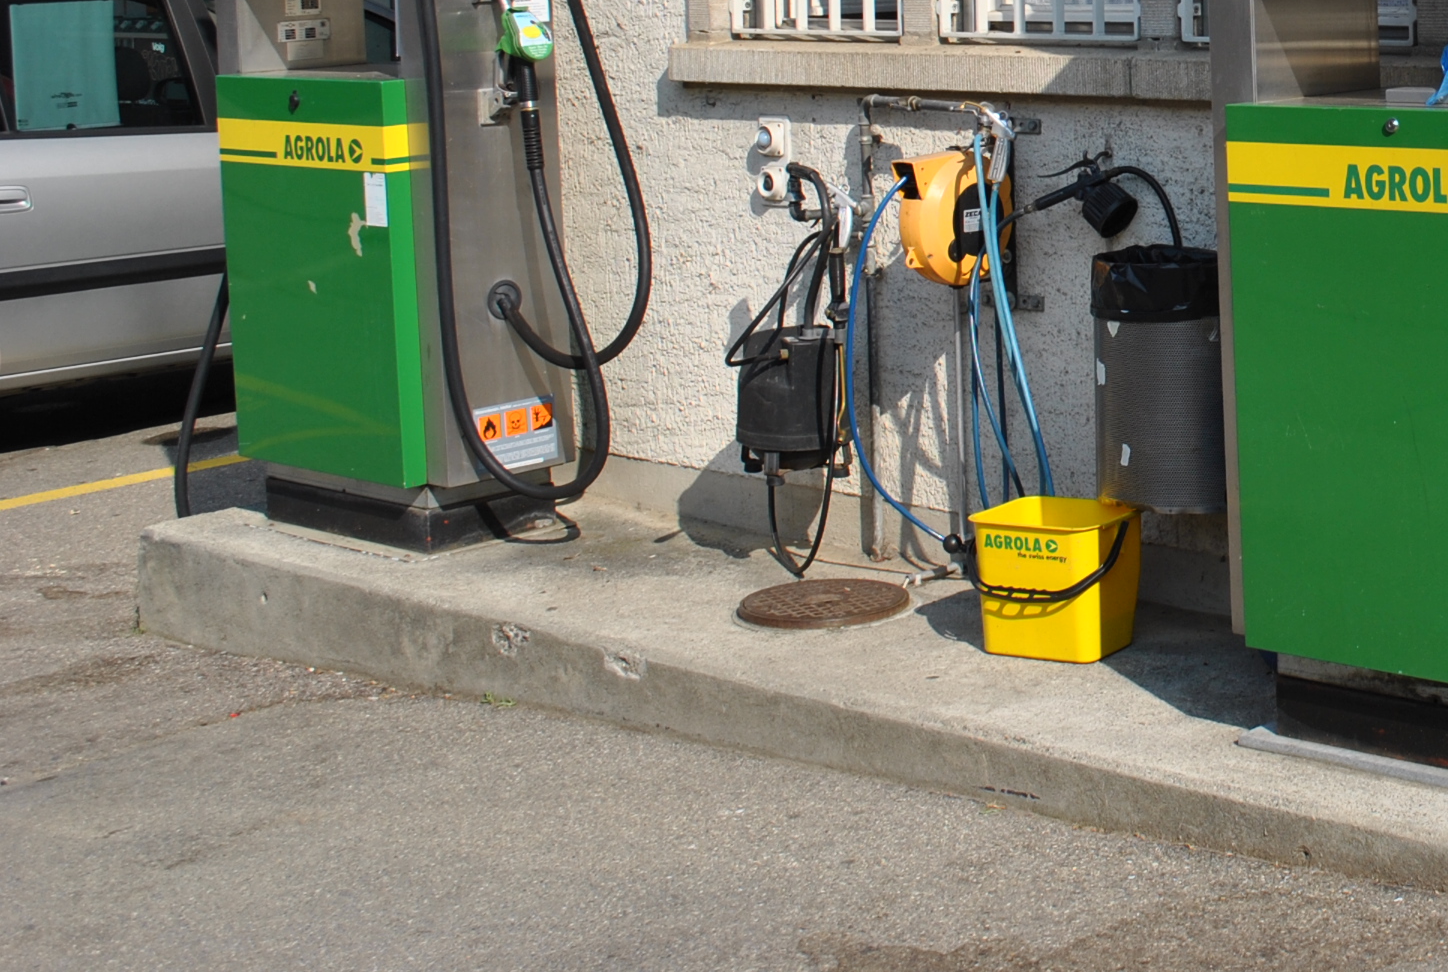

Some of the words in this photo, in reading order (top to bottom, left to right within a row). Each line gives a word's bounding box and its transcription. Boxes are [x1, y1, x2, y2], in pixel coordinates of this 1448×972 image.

[283, 134, 346, 164] AGROLA
[984, 533, 1042, 553] AGROLA
[1029, 552, 1044, 560] swiss
[1046, 555, 1067, 563] energy
